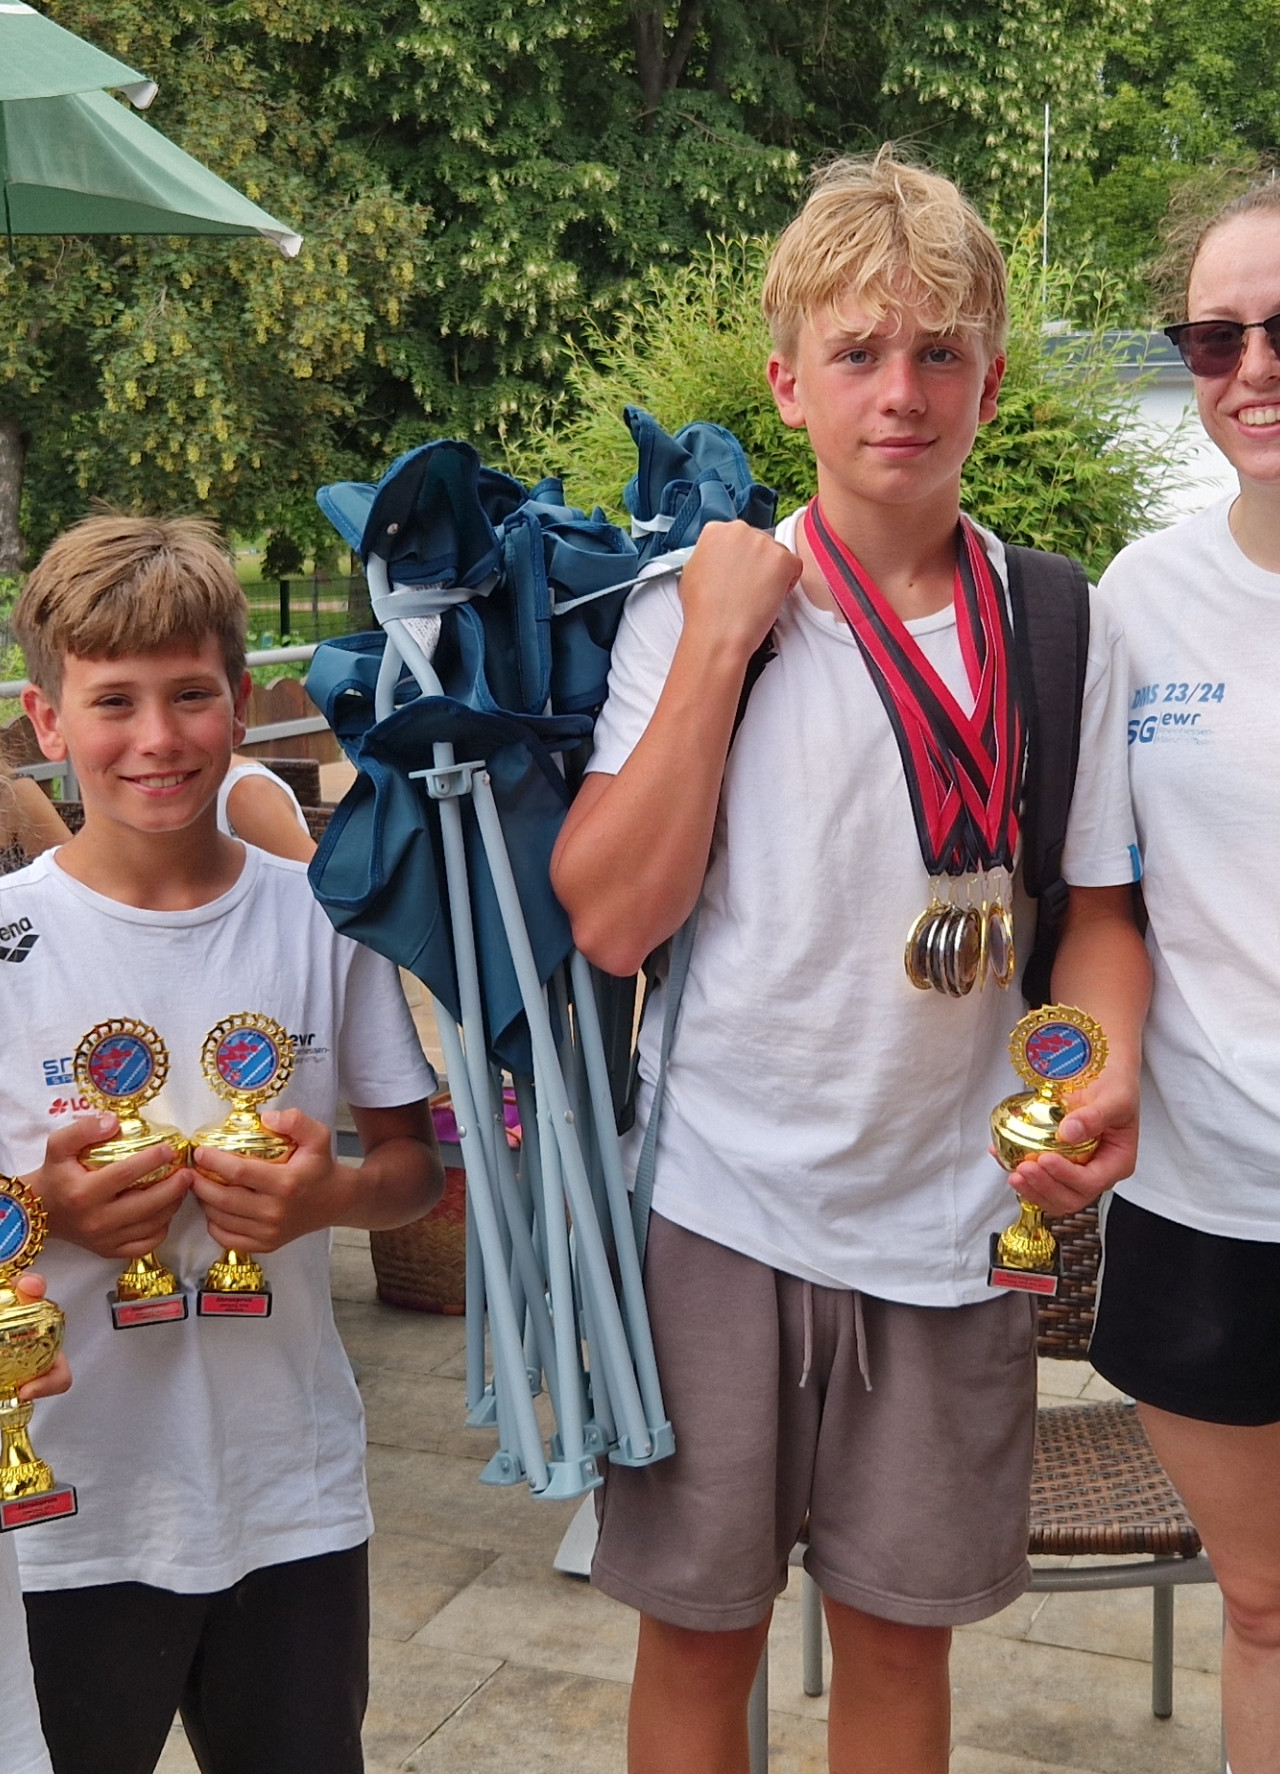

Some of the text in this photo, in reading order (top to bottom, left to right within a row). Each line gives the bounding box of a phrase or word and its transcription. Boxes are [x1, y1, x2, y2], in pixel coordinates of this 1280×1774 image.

[1131, 683, 1225, 710] DMS 23/24
[1128, 716, 1158, 745] SG
[1162, 712, 1201, 725] ewr
